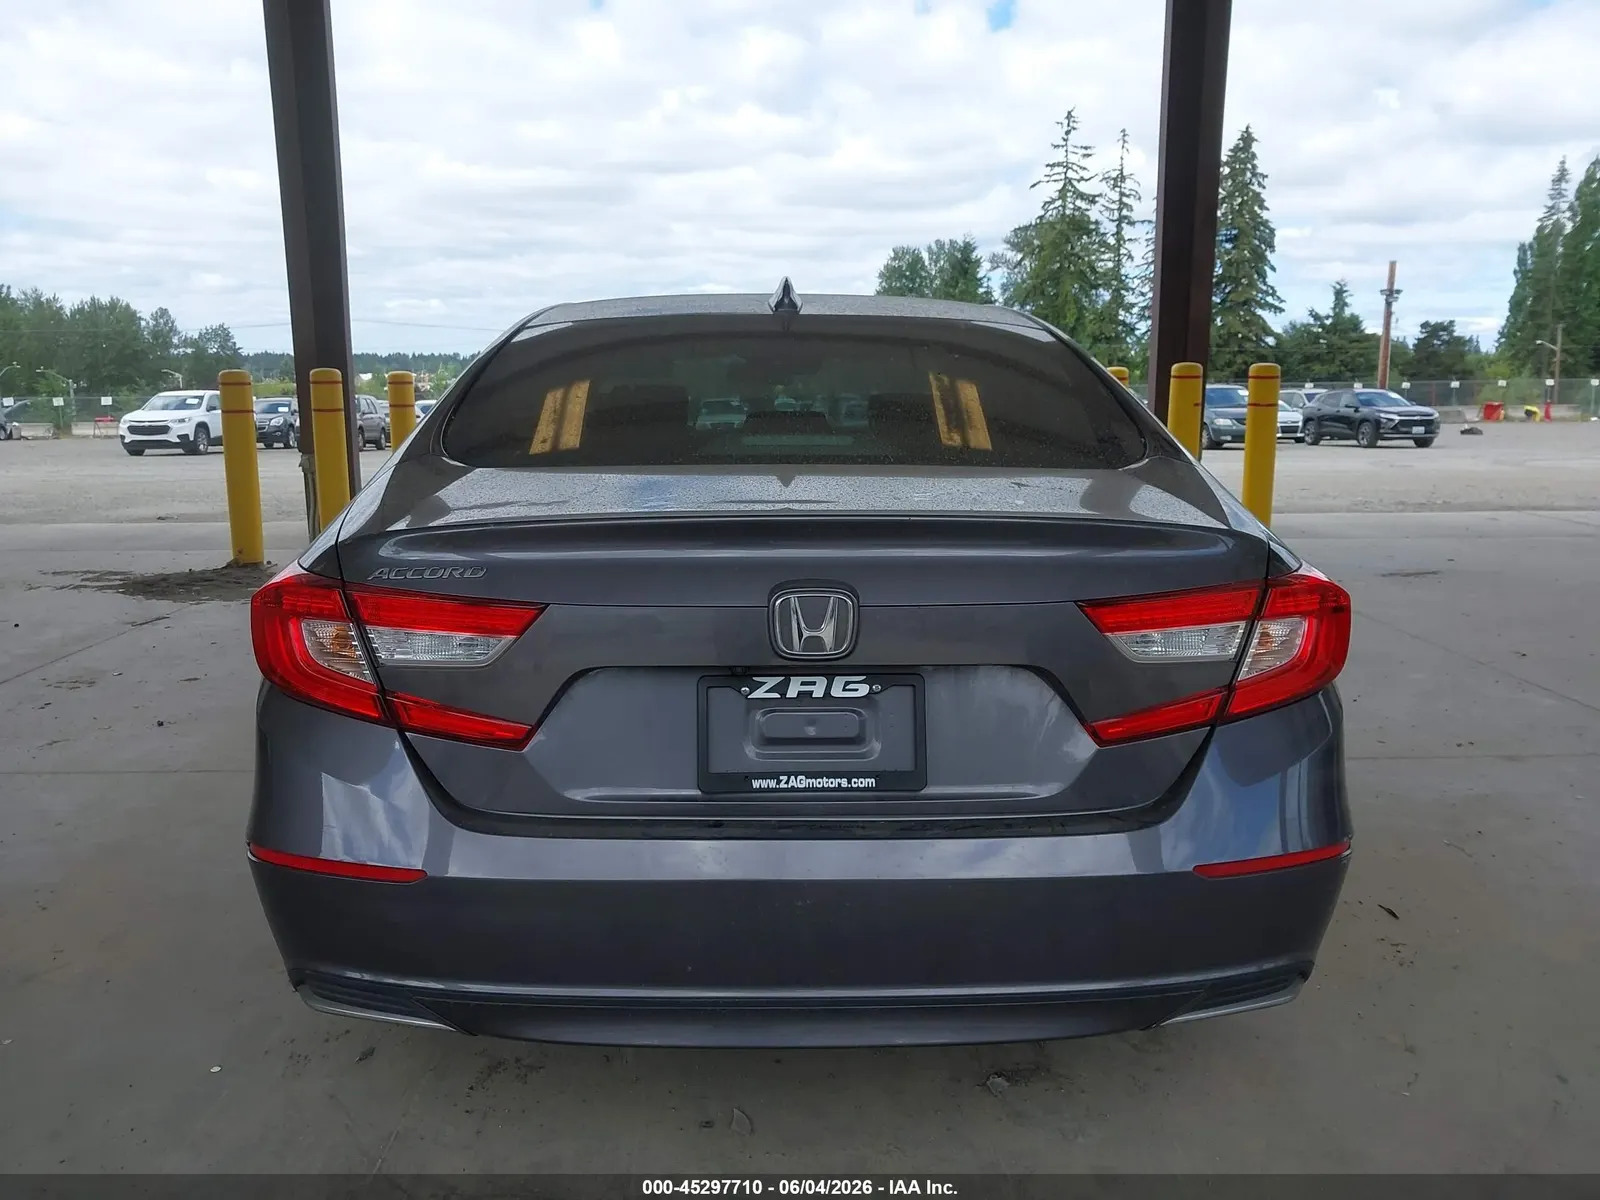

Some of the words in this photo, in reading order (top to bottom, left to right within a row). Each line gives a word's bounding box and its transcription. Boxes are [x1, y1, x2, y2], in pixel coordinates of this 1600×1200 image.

[366, 566, 487, 581] ACCORD
[746, 675, 871, 699] ZAG
[751, 775, 876, 789] www.ZAGmotors.com
